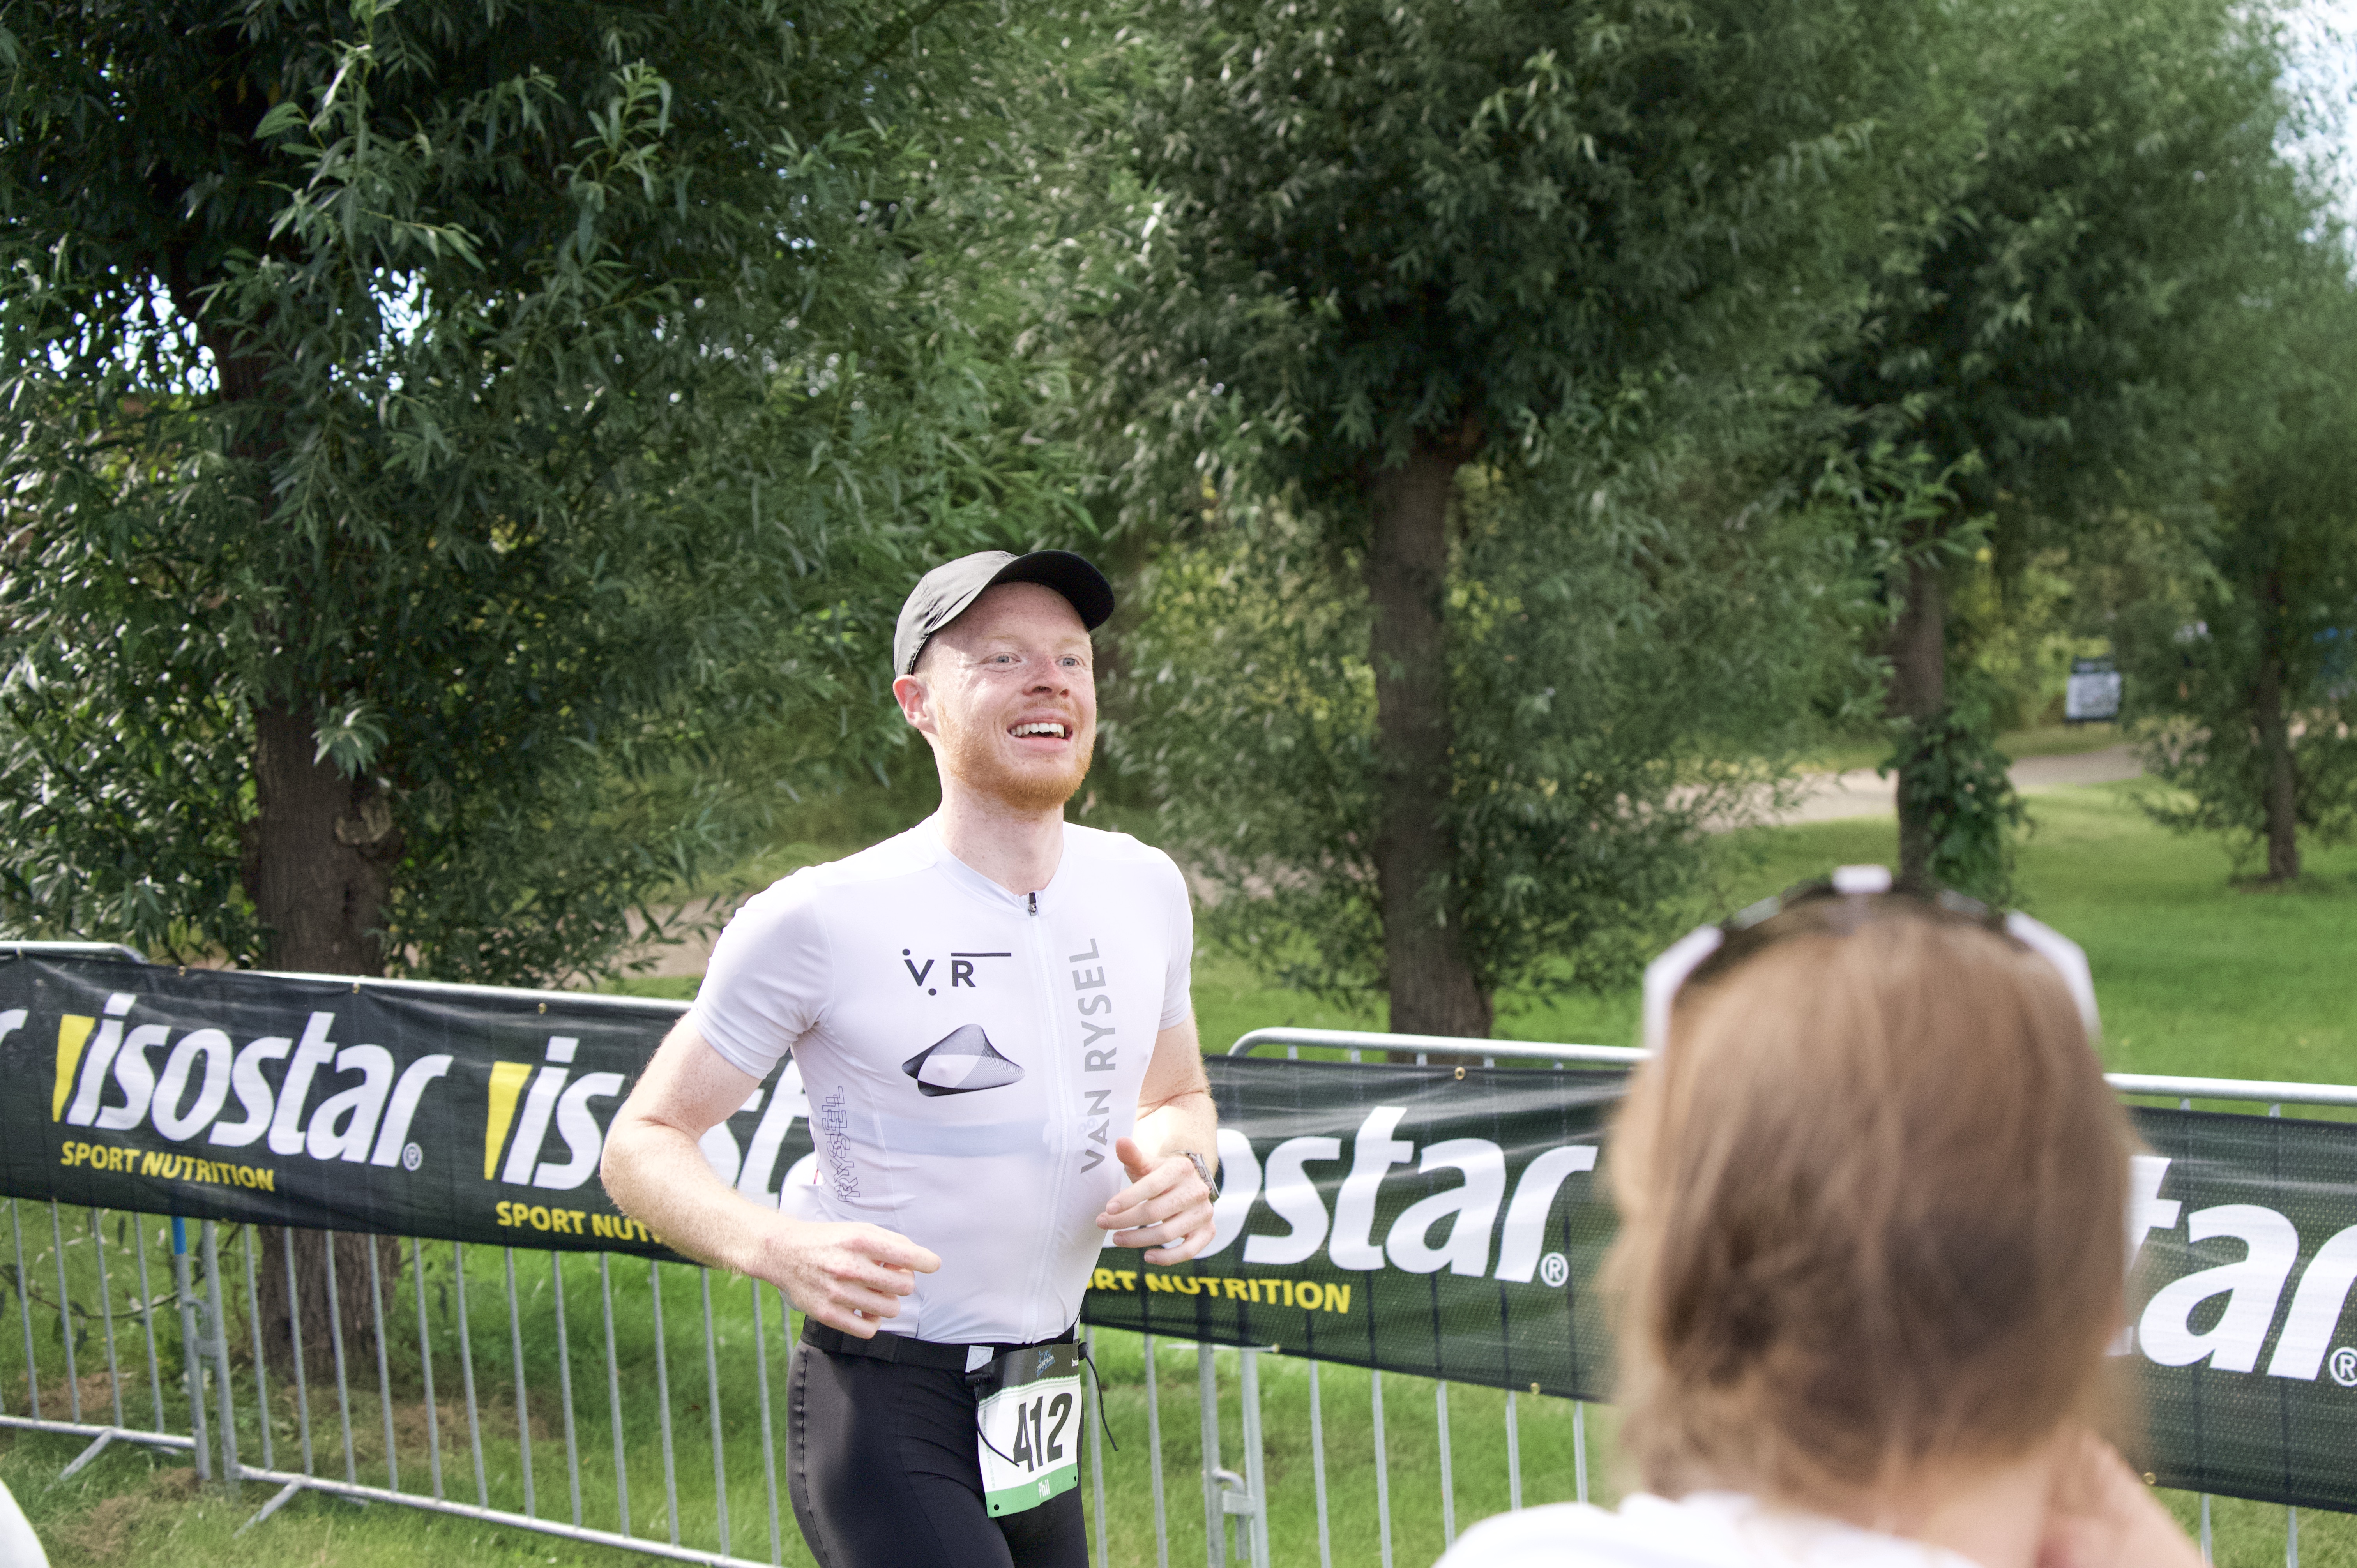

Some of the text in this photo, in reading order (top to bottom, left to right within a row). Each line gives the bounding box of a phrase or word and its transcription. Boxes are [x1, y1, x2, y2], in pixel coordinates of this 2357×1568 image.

[1069, 938, 1117, 1174] VAN RYSEL
[61, 1141, 275, 1191] SPORT NUTRITION
[495, 1201, 586, 1235] SPORT
[1145, 1272, 1351, 1314] NUTRITION
[1013, 1393, 1072, 1473] 412
[1038, 1478, 1050, 1499] Phil
